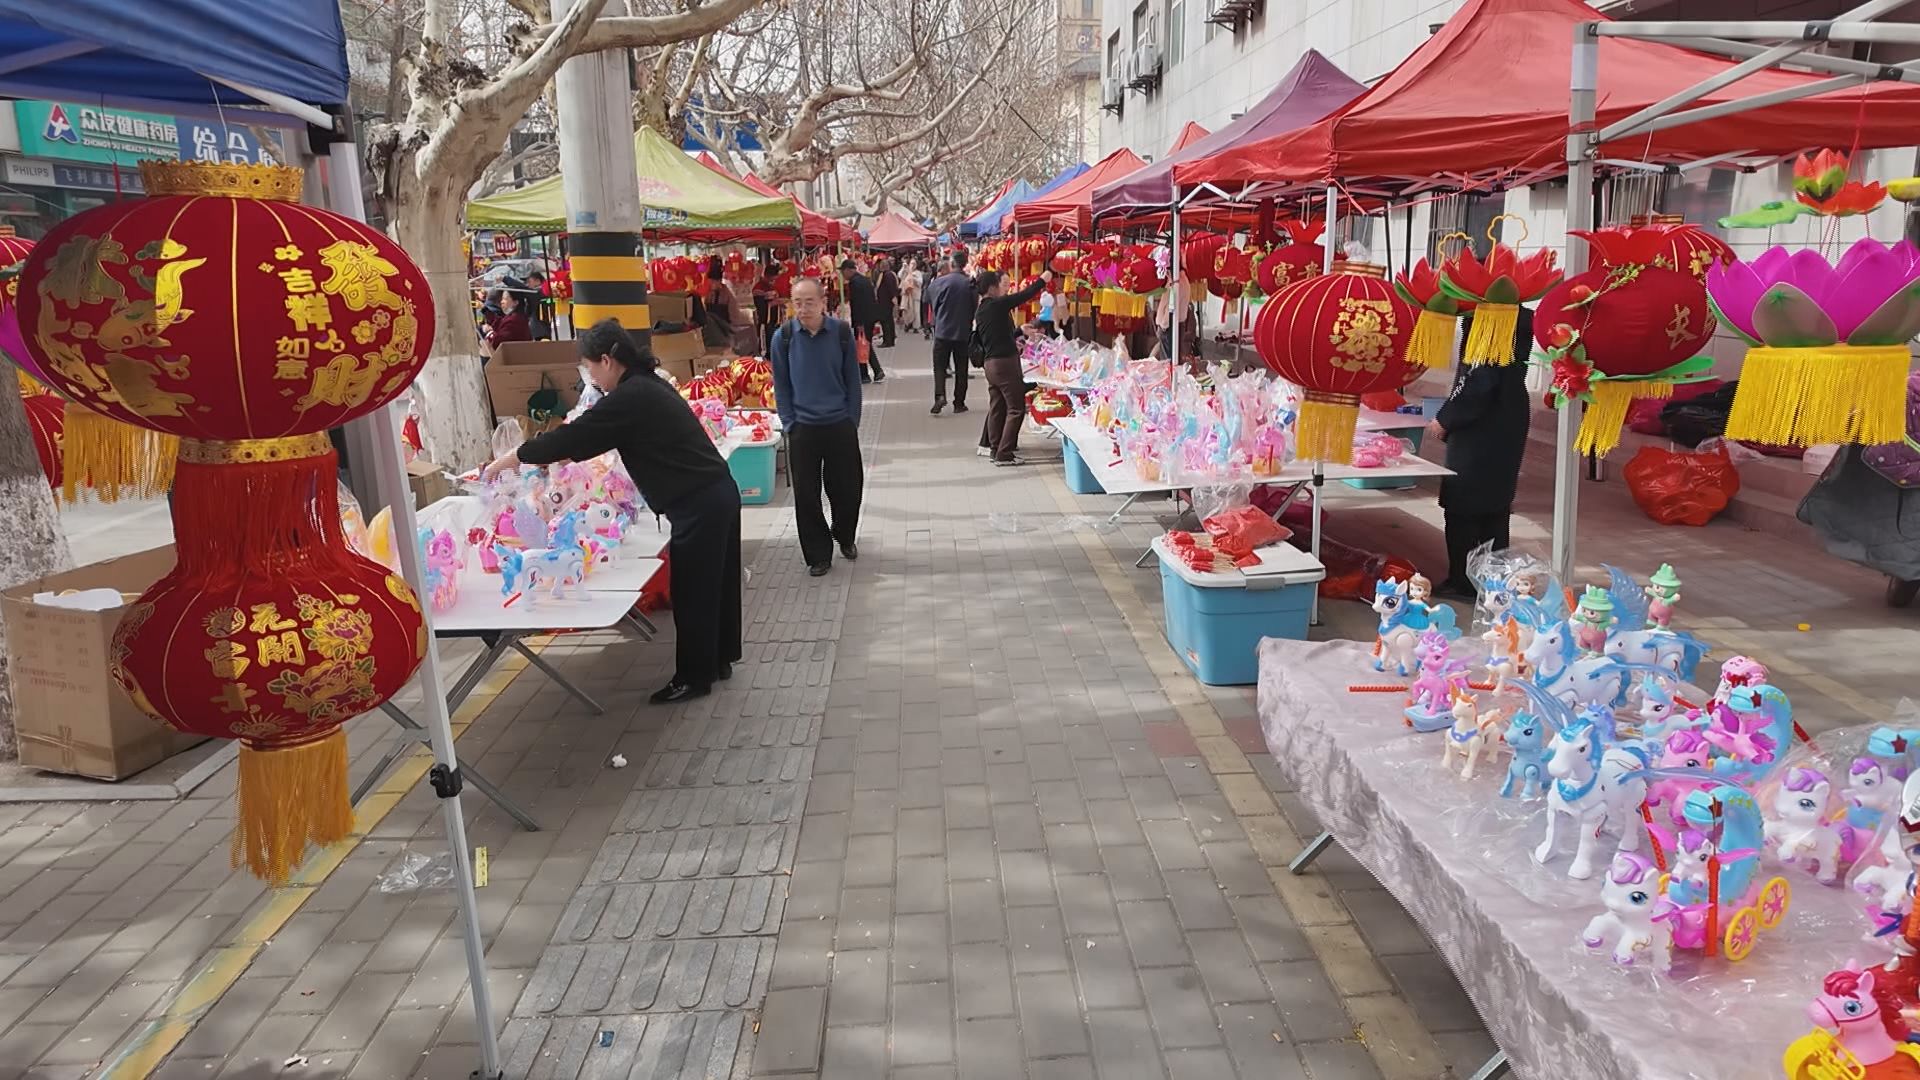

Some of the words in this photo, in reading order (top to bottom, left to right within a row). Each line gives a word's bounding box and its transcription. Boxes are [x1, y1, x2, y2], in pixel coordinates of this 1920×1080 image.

[12, 164, 49, 178] PHILIPS
[273, 267, 333, 380] 吉祥如意
